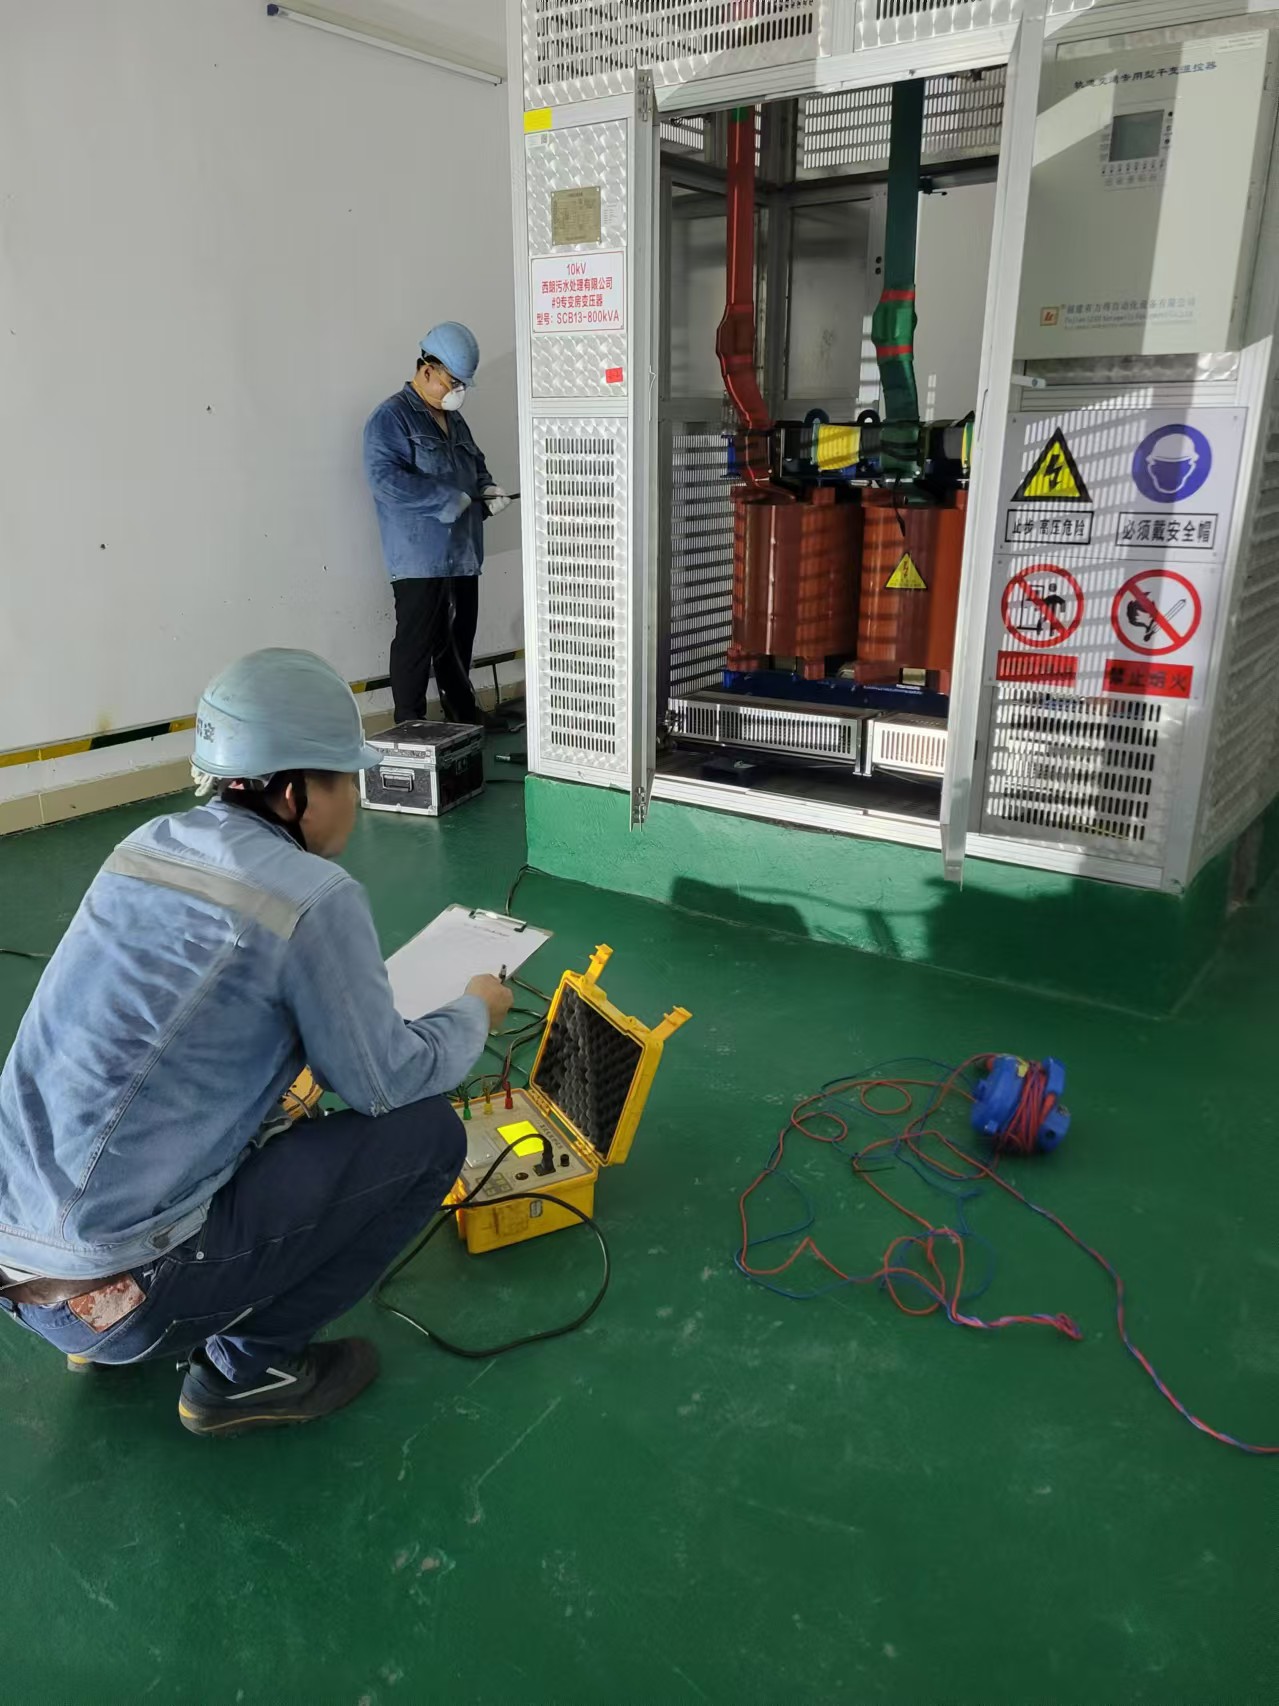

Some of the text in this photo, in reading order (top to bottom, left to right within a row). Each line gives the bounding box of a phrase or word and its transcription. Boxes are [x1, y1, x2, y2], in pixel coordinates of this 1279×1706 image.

[567, 262, 586, 276] 10kV
[541, 276, 613, 294] 西朗污水处理有限公司
[551, 293, 603, 309] #9专变房变压器
[1121, 519, 1213, 543] 必须戴安全帽
[1109, 665, 1187, 693] 禁止明火
